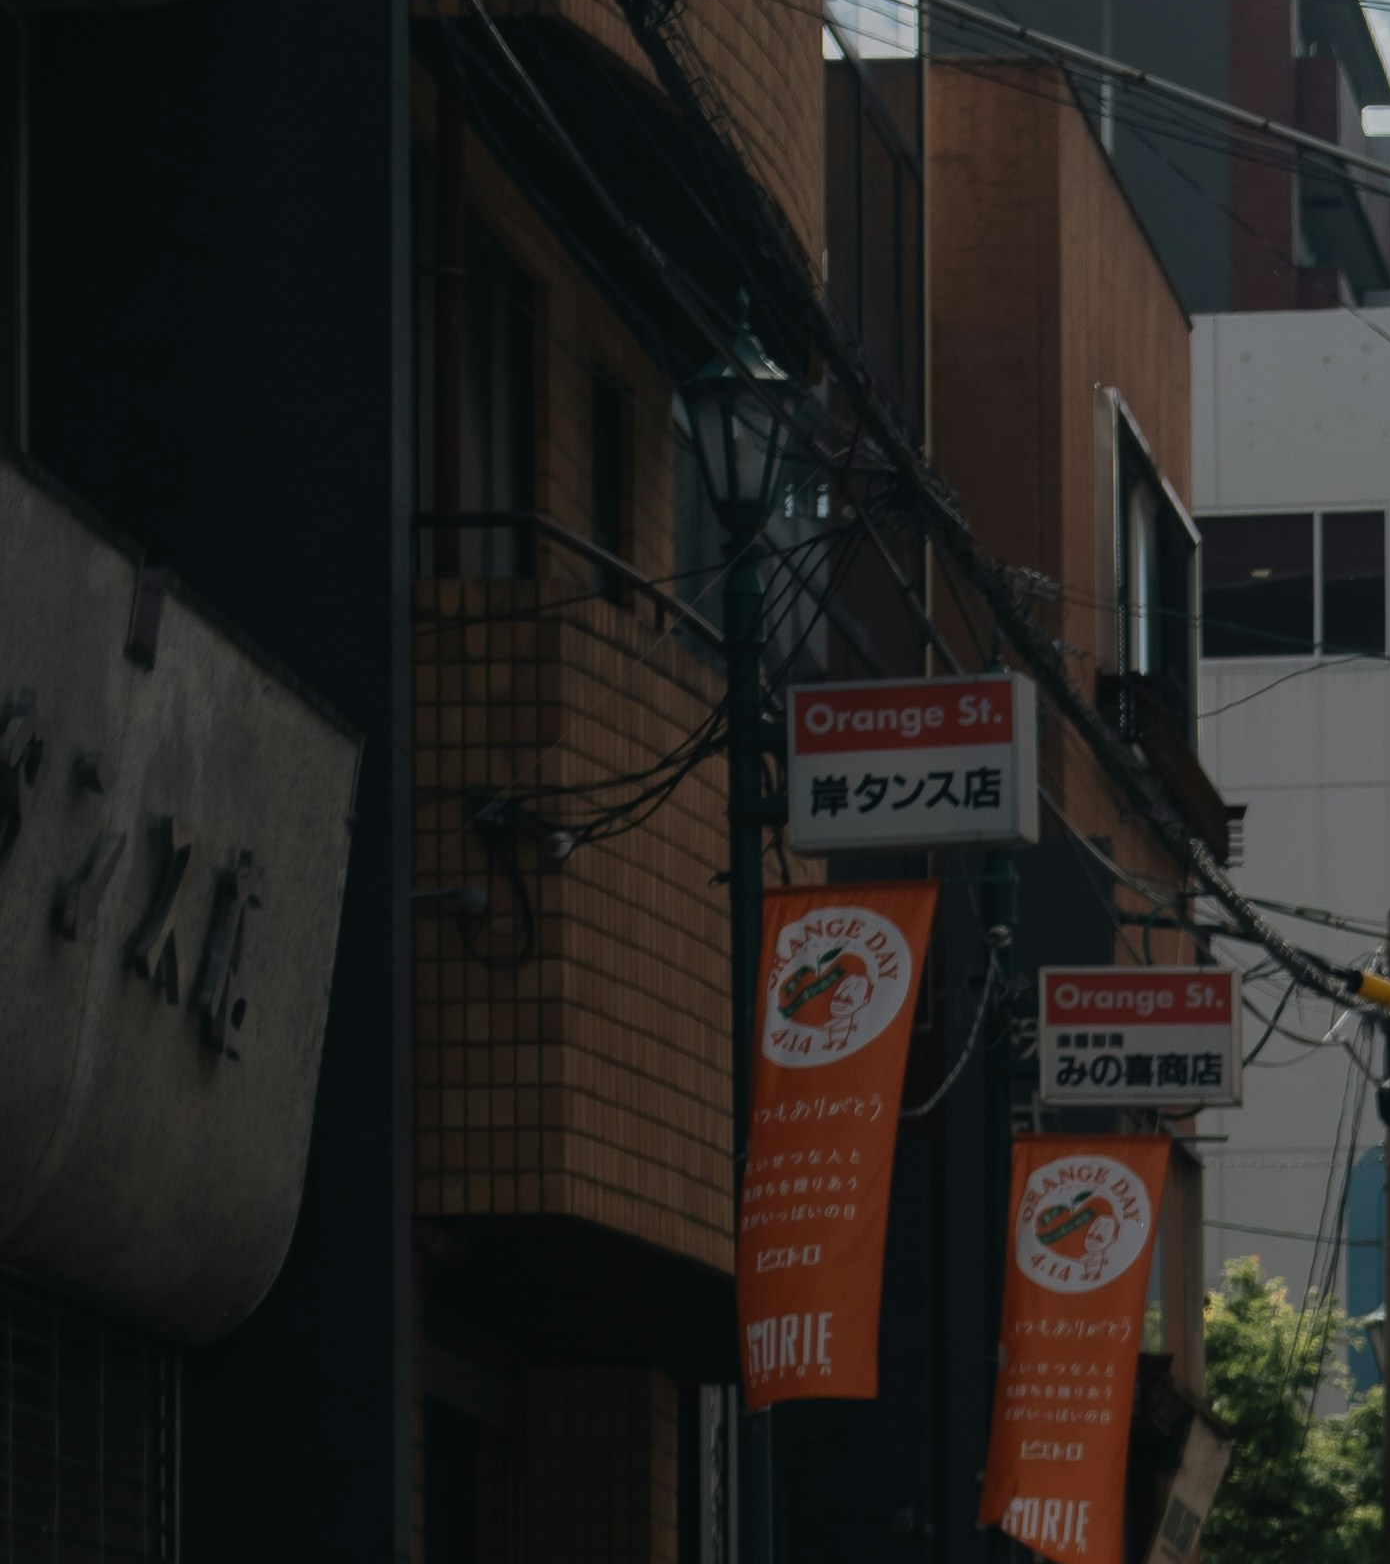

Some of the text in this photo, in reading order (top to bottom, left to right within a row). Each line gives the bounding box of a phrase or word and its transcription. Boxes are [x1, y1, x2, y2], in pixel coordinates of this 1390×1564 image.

[805, 693, 1002, 737] Orange St.
[811, 768, 1002, 817] 岸タンス店
[866, 931, 897, 982] DAY
[1055, 981, 1224, 1017] Orange St.
[1055, 1053, 1224, 1087] みの喜商店
[1023, 1164, 1141, 1224] ORANGE DAY
